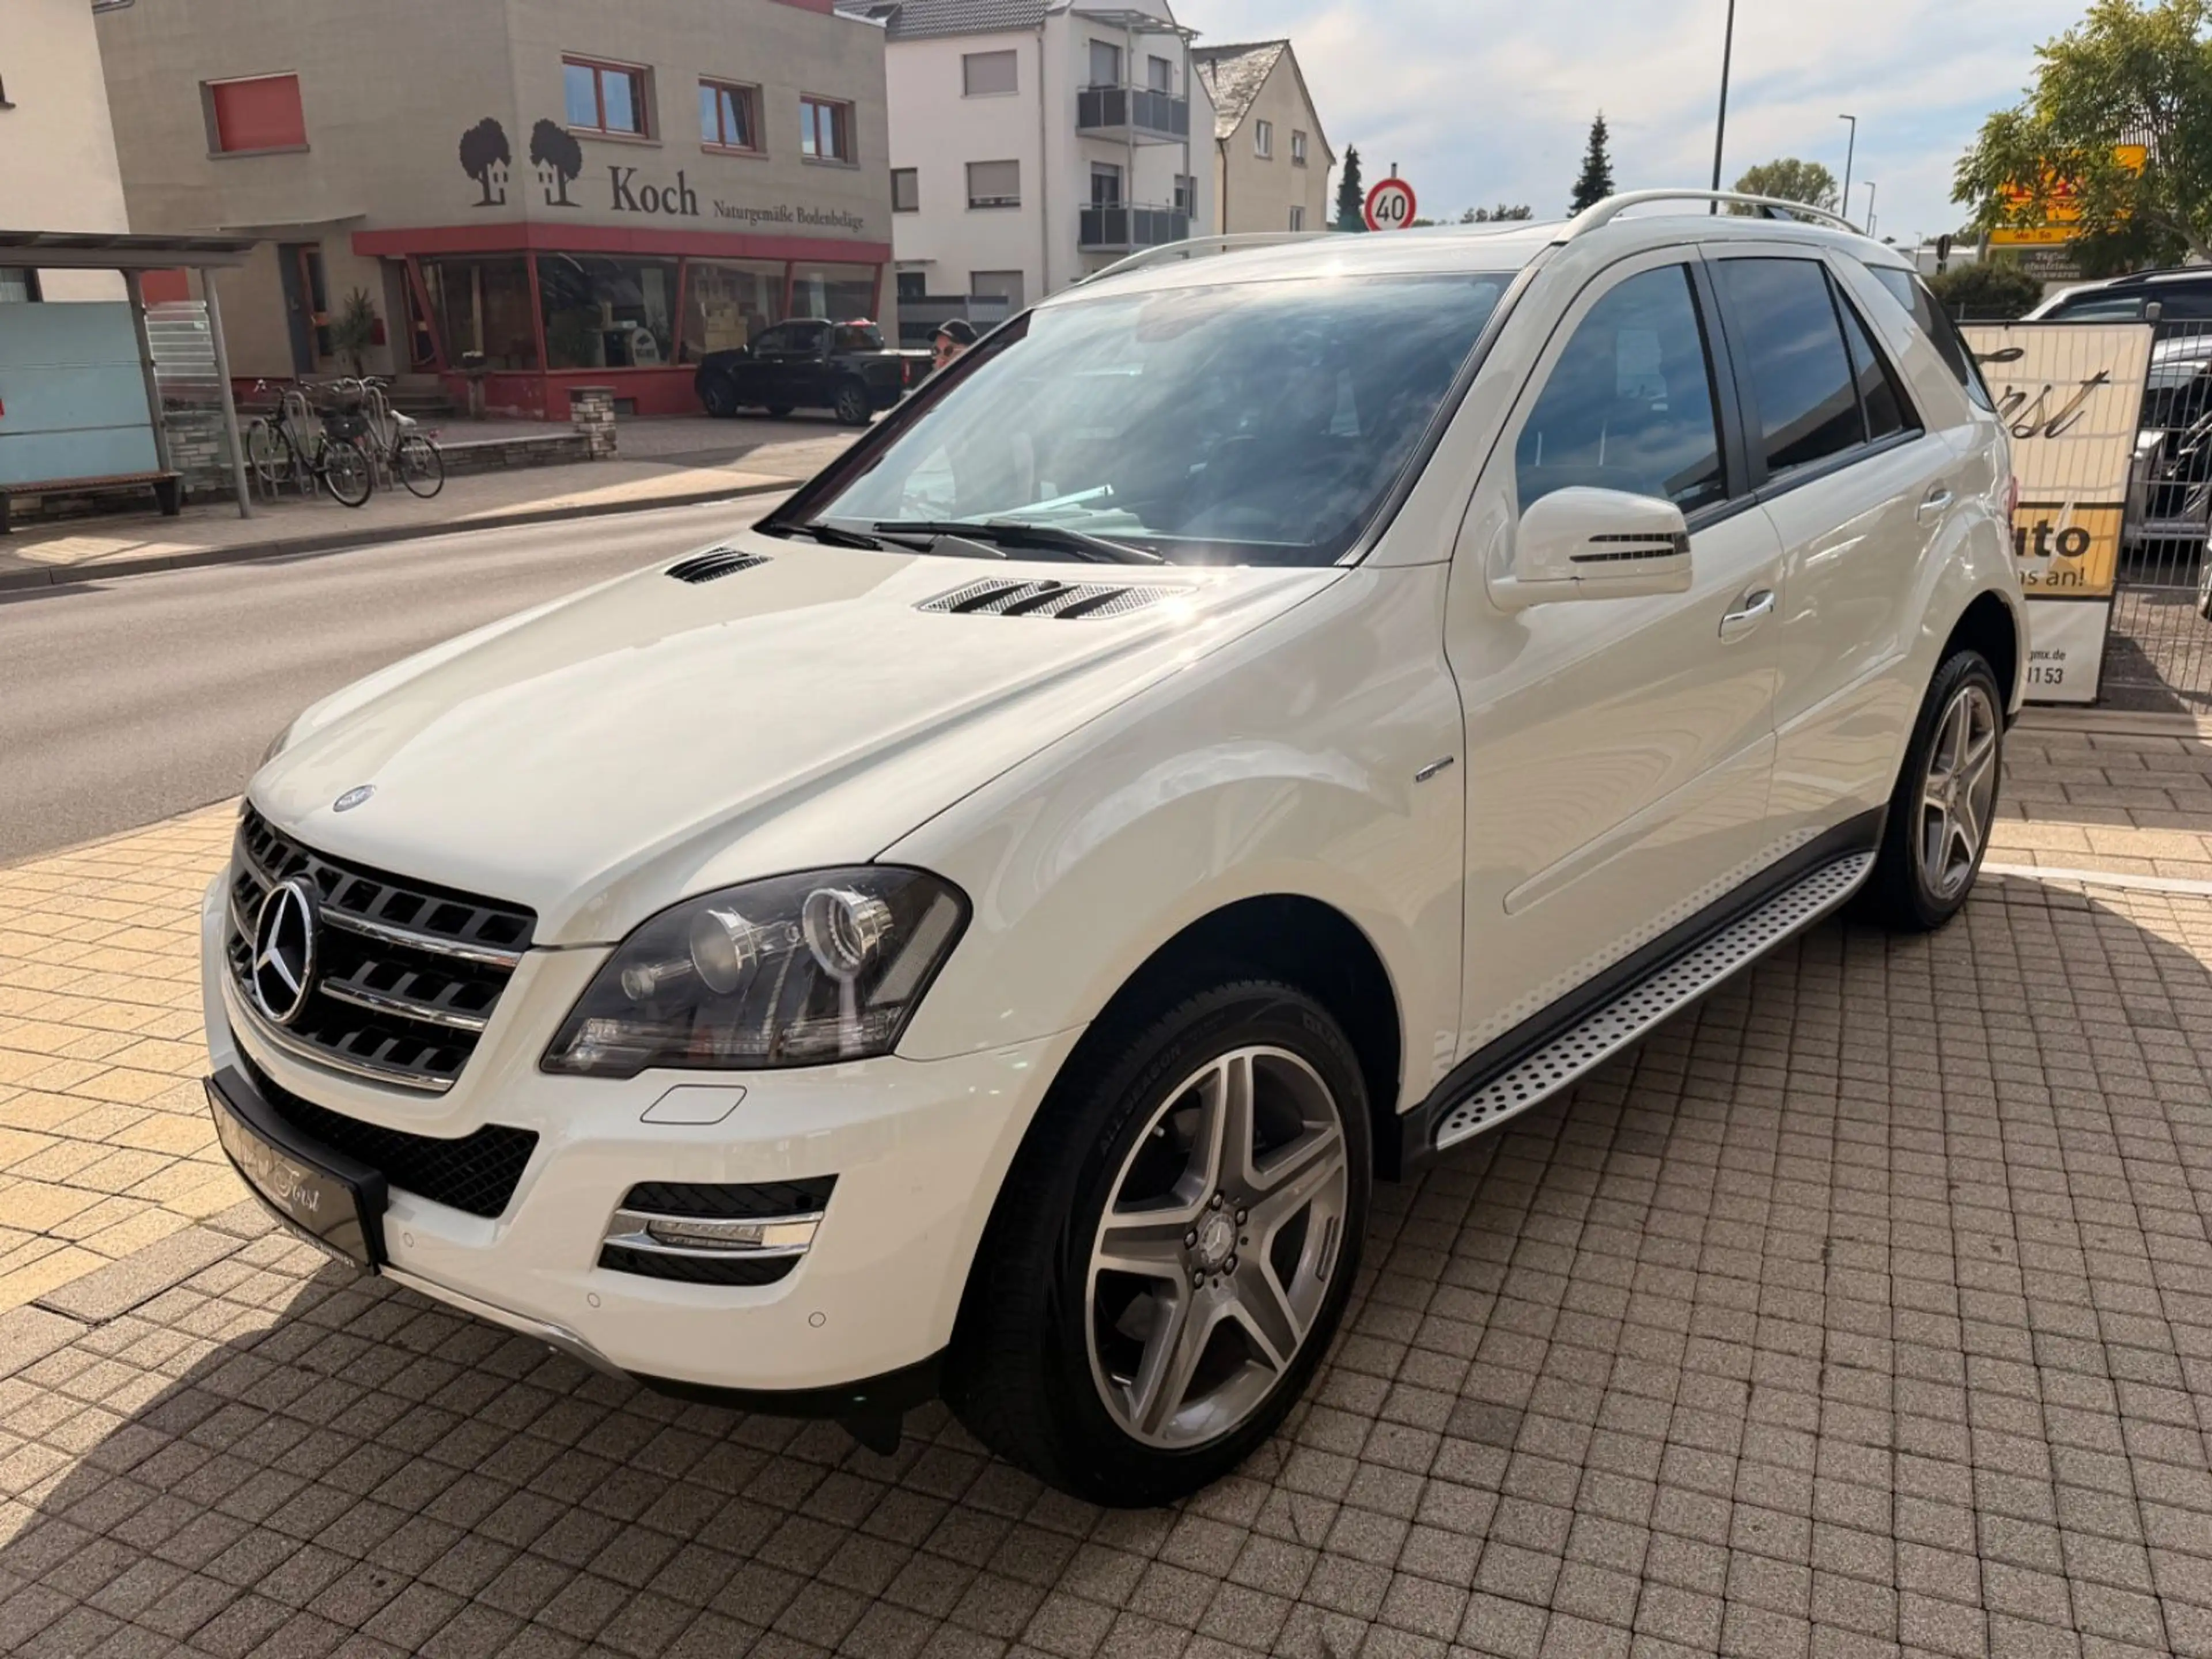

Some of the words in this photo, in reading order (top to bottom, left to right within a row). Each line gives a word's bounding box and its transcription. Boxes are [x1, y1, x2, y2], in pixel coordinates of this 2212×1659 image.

[607, 165, 700, 215] Koch
[713, 200, 793, 226] Naturgemäße
[798, 206, 863, 233] Bodenbeläge
[1376, 195, 1405, 222] 40
[2046, 567, 2085, 587] an!
